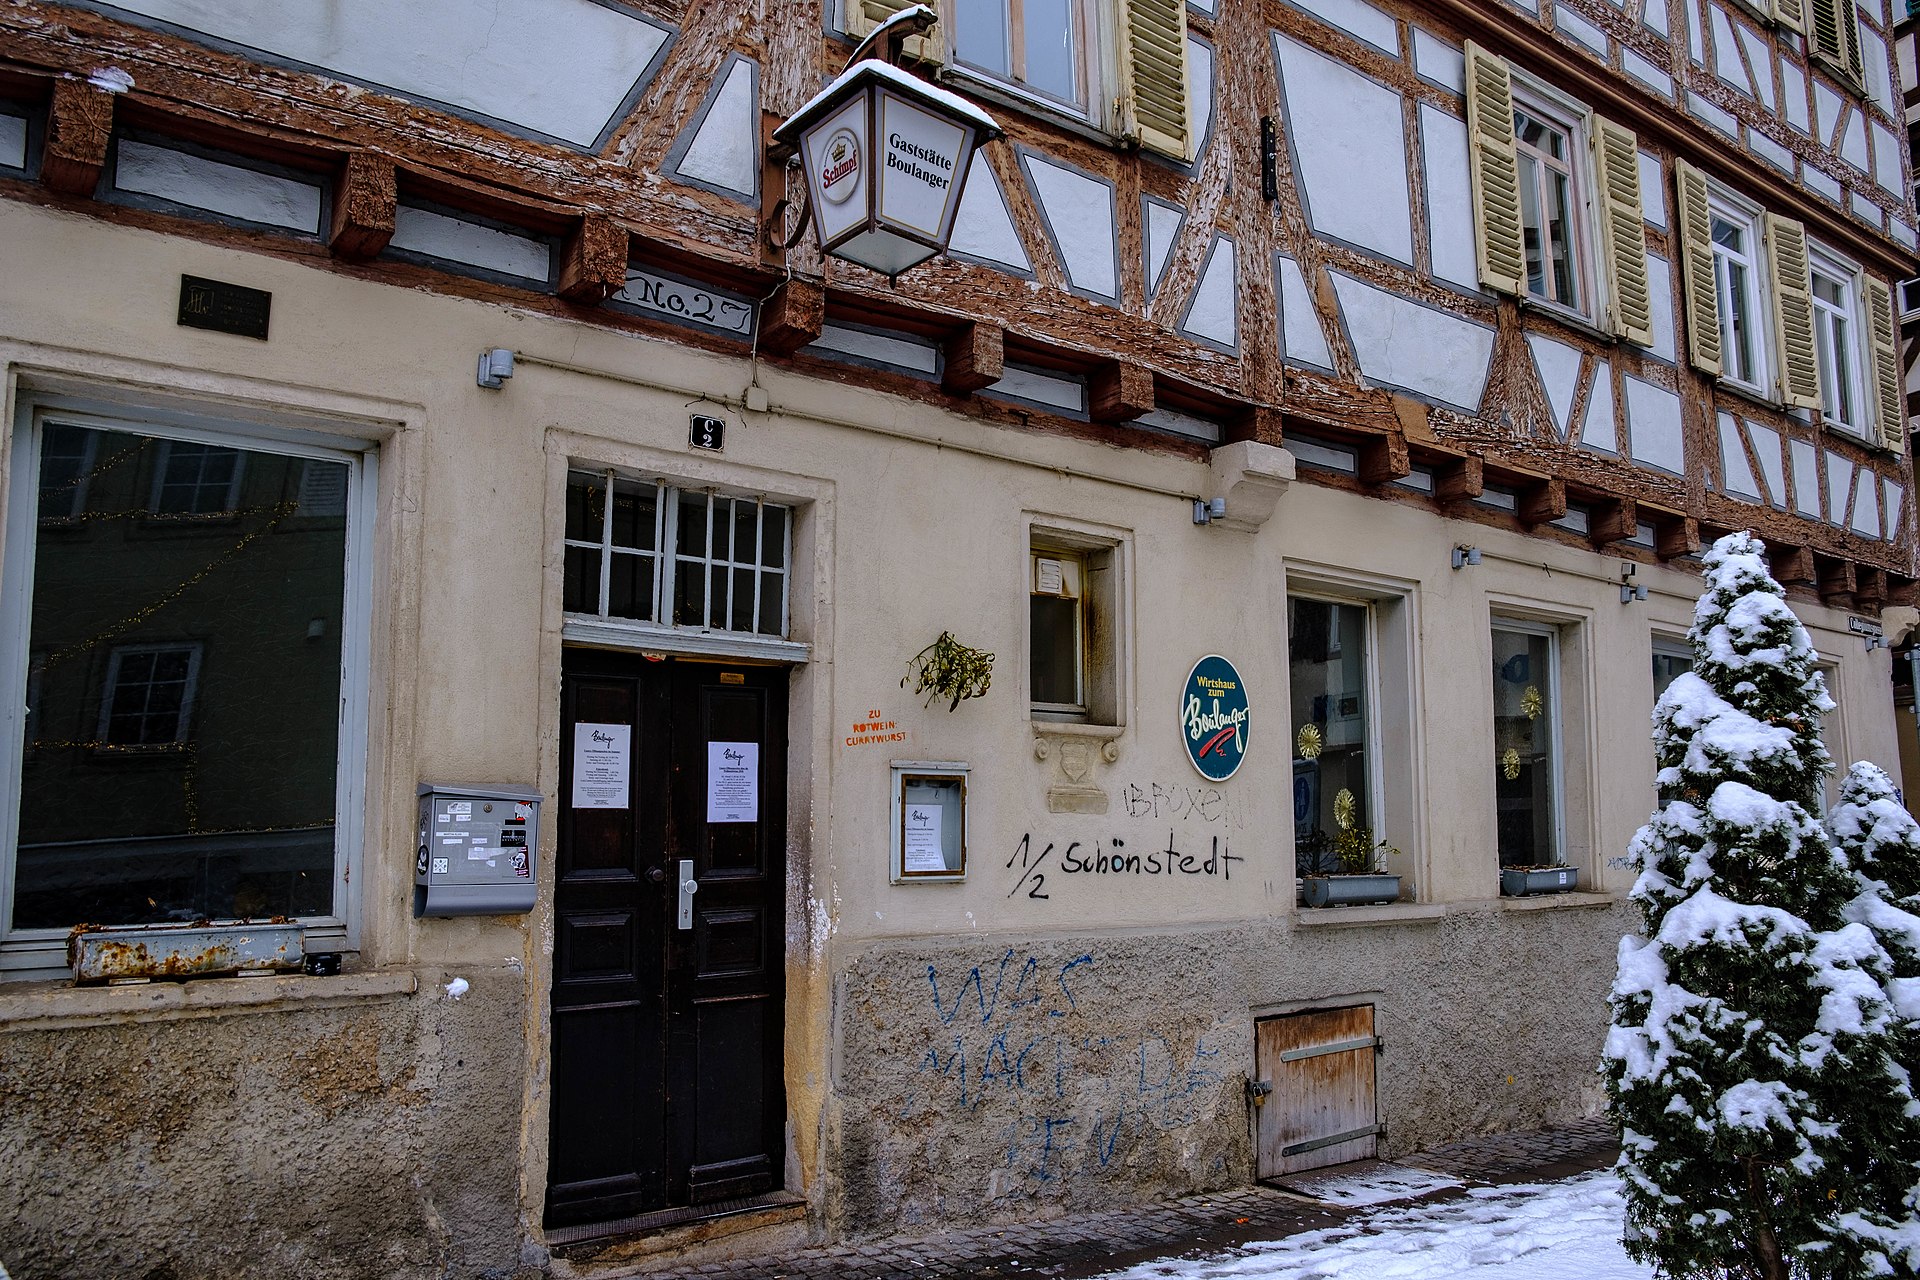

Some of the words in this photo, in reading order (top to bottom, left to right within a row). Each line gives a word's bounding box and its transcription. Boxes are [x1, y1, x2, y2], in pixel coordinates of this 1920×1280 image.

[822, 149, 857, 189] Schimpf
[887, 152, 950, 190] Boulanger
[889, 133, 952, 171] Gaststätte
[1197, 675, 1236, 690] Wirtshaus
[1207, 688, 1225, 698] zum
[868, 709, 881, 719] ZU
[1183, 693, 1250, 754] Boulanger
[845, 731, 907, 747] CURRYWURST
[1061, 827, 1245, 880] Schönstedt
